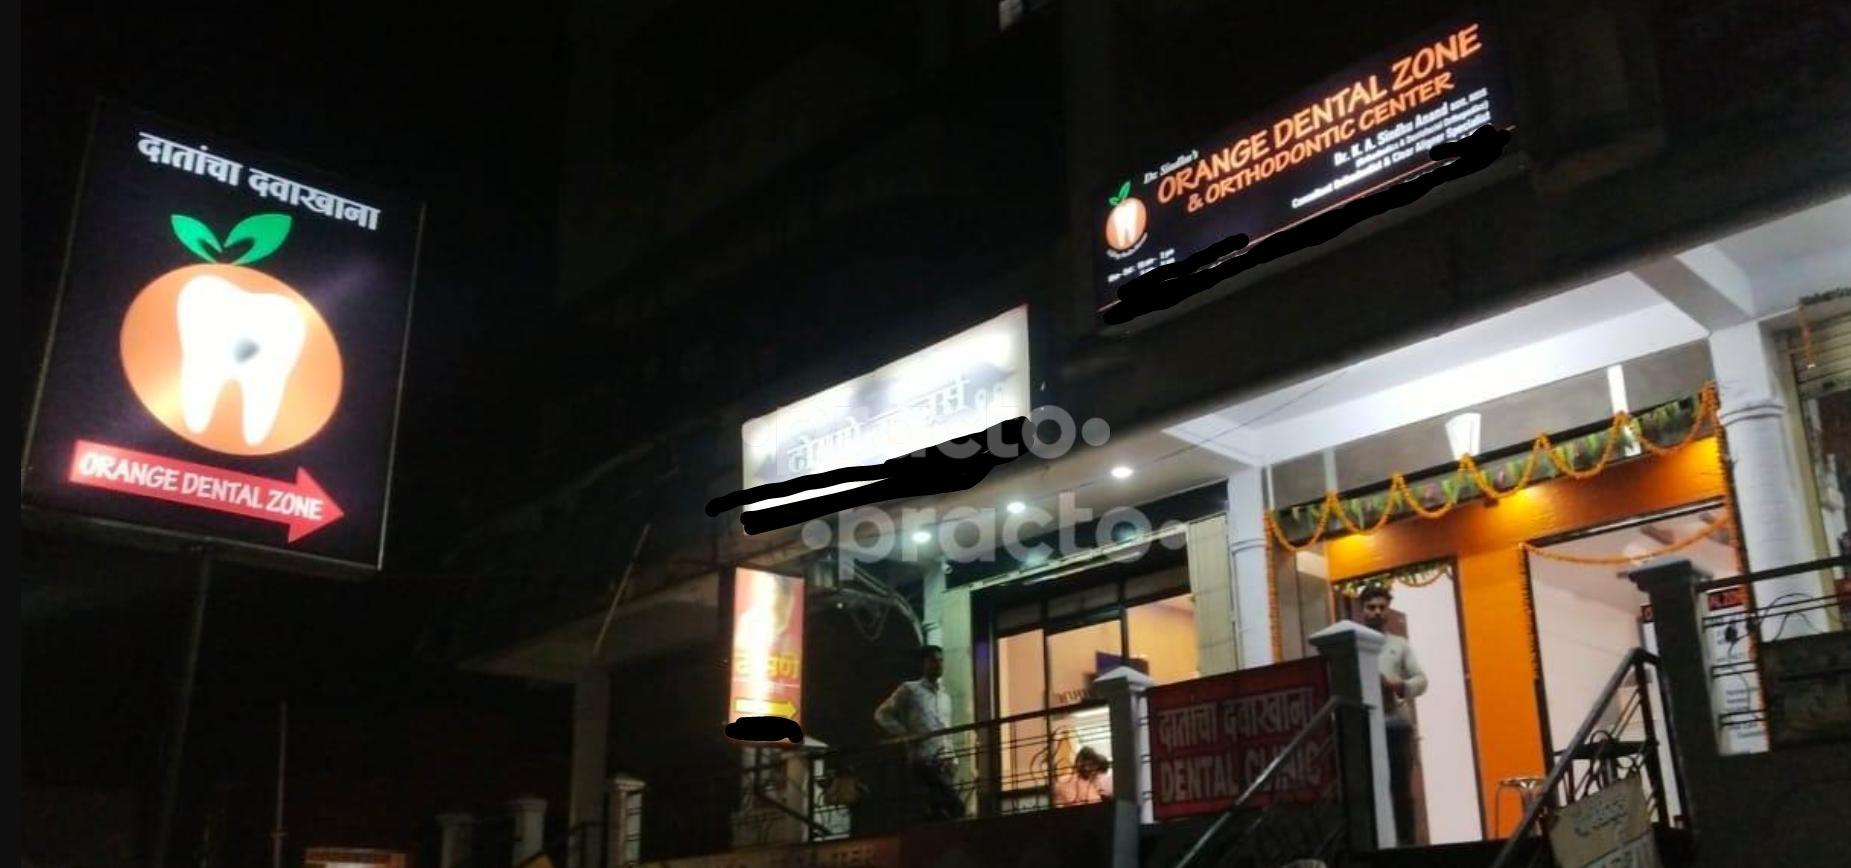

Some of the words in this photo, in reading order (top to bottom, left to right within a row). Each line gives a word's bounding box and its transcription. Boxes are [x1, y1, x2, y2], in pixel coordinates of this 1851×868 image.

[1158, 129, 1271, 203] ORANGE
[1273, 75, 1387, 149] DENTAL
[1391, 23, 1482, 91] ZONE
[1188, 193, 1204, 213] &
[1205, 117, 1356, 204] ORTHODONTIC
[1359, 71, 1455, 131] CENTER
[138, 131, 242, 186] दातांचा
[249, 167, 381, 231] दवाखाना
[78, 452, 179, 492] ORANGE
[182, 472, 263, 508] DENTAL
[267, 490, 324, 521] ZONE
[1222, 686, 1314, 742] दवाखाना
[1160, 752, 1239, 803] DENTAL
